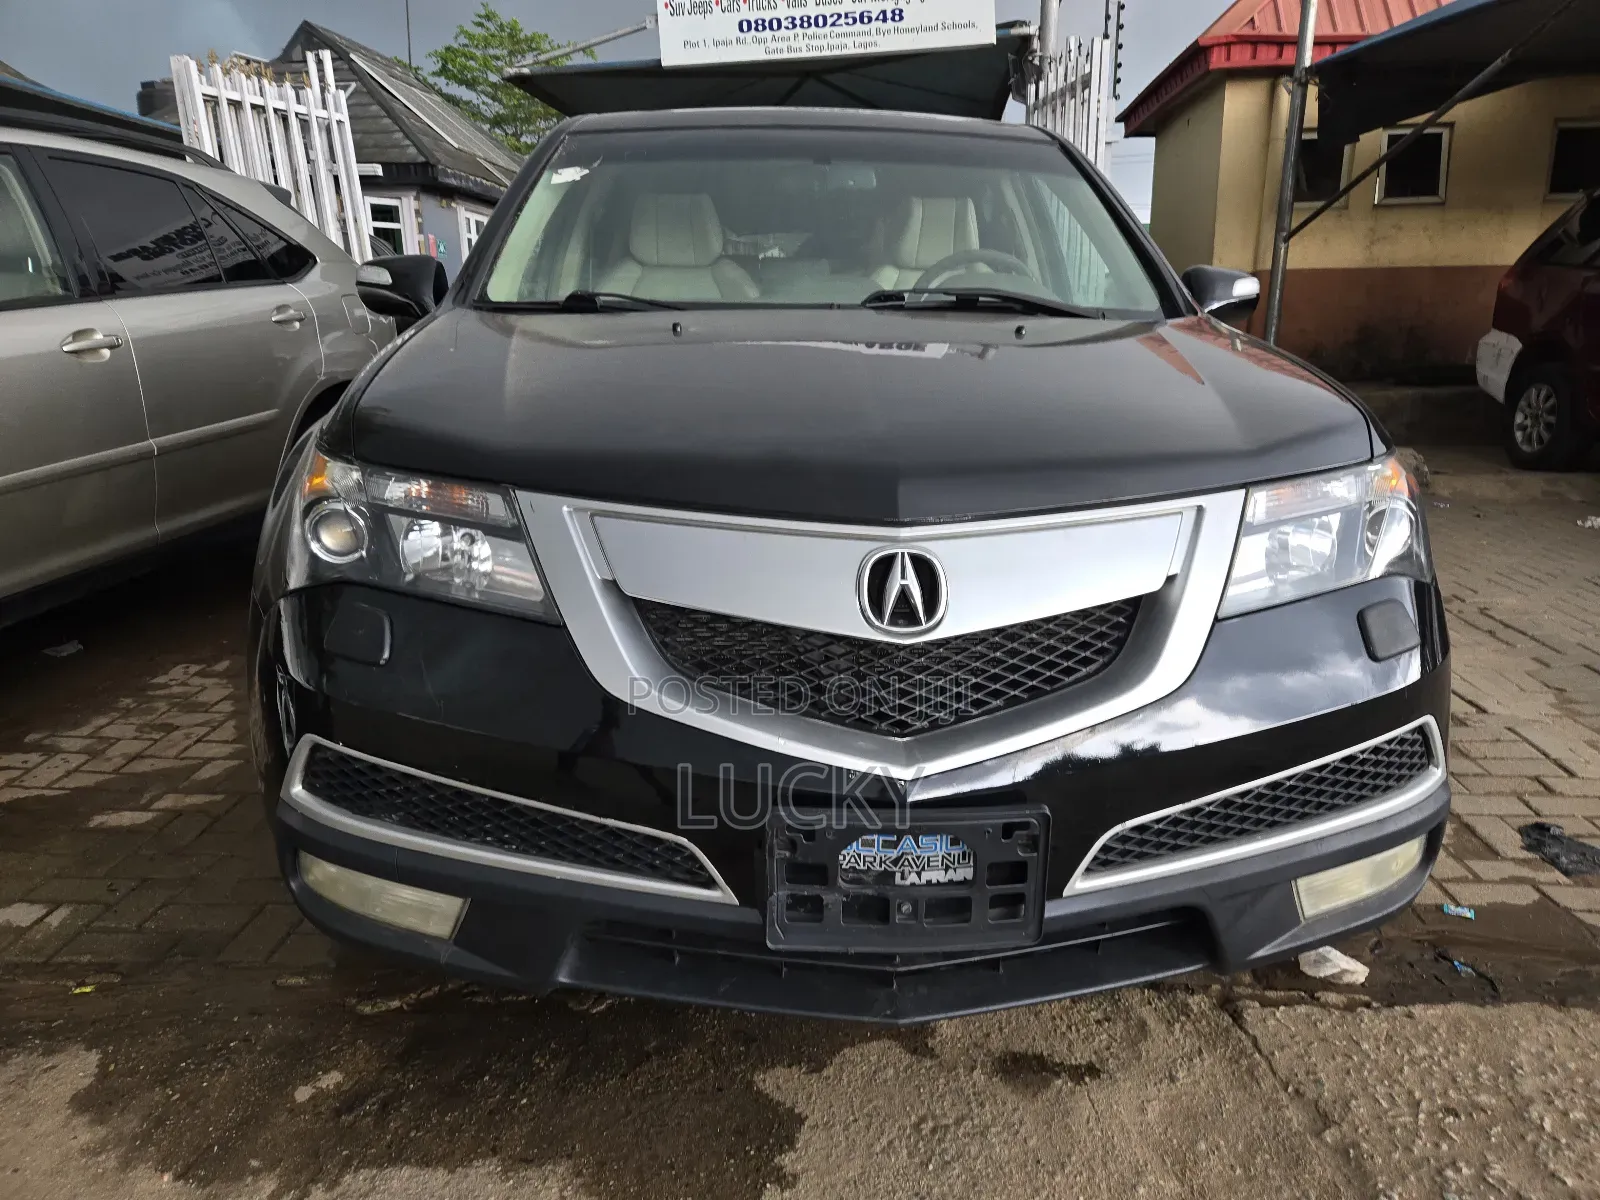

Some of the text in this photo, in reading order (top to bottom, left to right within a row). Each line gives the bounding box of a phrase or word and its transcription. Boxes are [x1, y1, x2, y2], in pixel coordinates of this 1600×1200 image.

[669, 0, 686, 17] Suv
[687, 0, 714, 19] Jeeps
[720, 0, 741, 13] Cars
[737, 8, 905, 34] 08038025648
[683, 39, 700, 50] Plot
[712, 36, 733, 49] Ipaja
[770, 34, 791, 44] Area
[802, 30, 828, 42] Police
[875, 26, 892, 37] Bye
[893, 23, 938, 36] Honeyland
[764, 45, 784, 56] Gate
[787, 44, 803, 55] Bus
